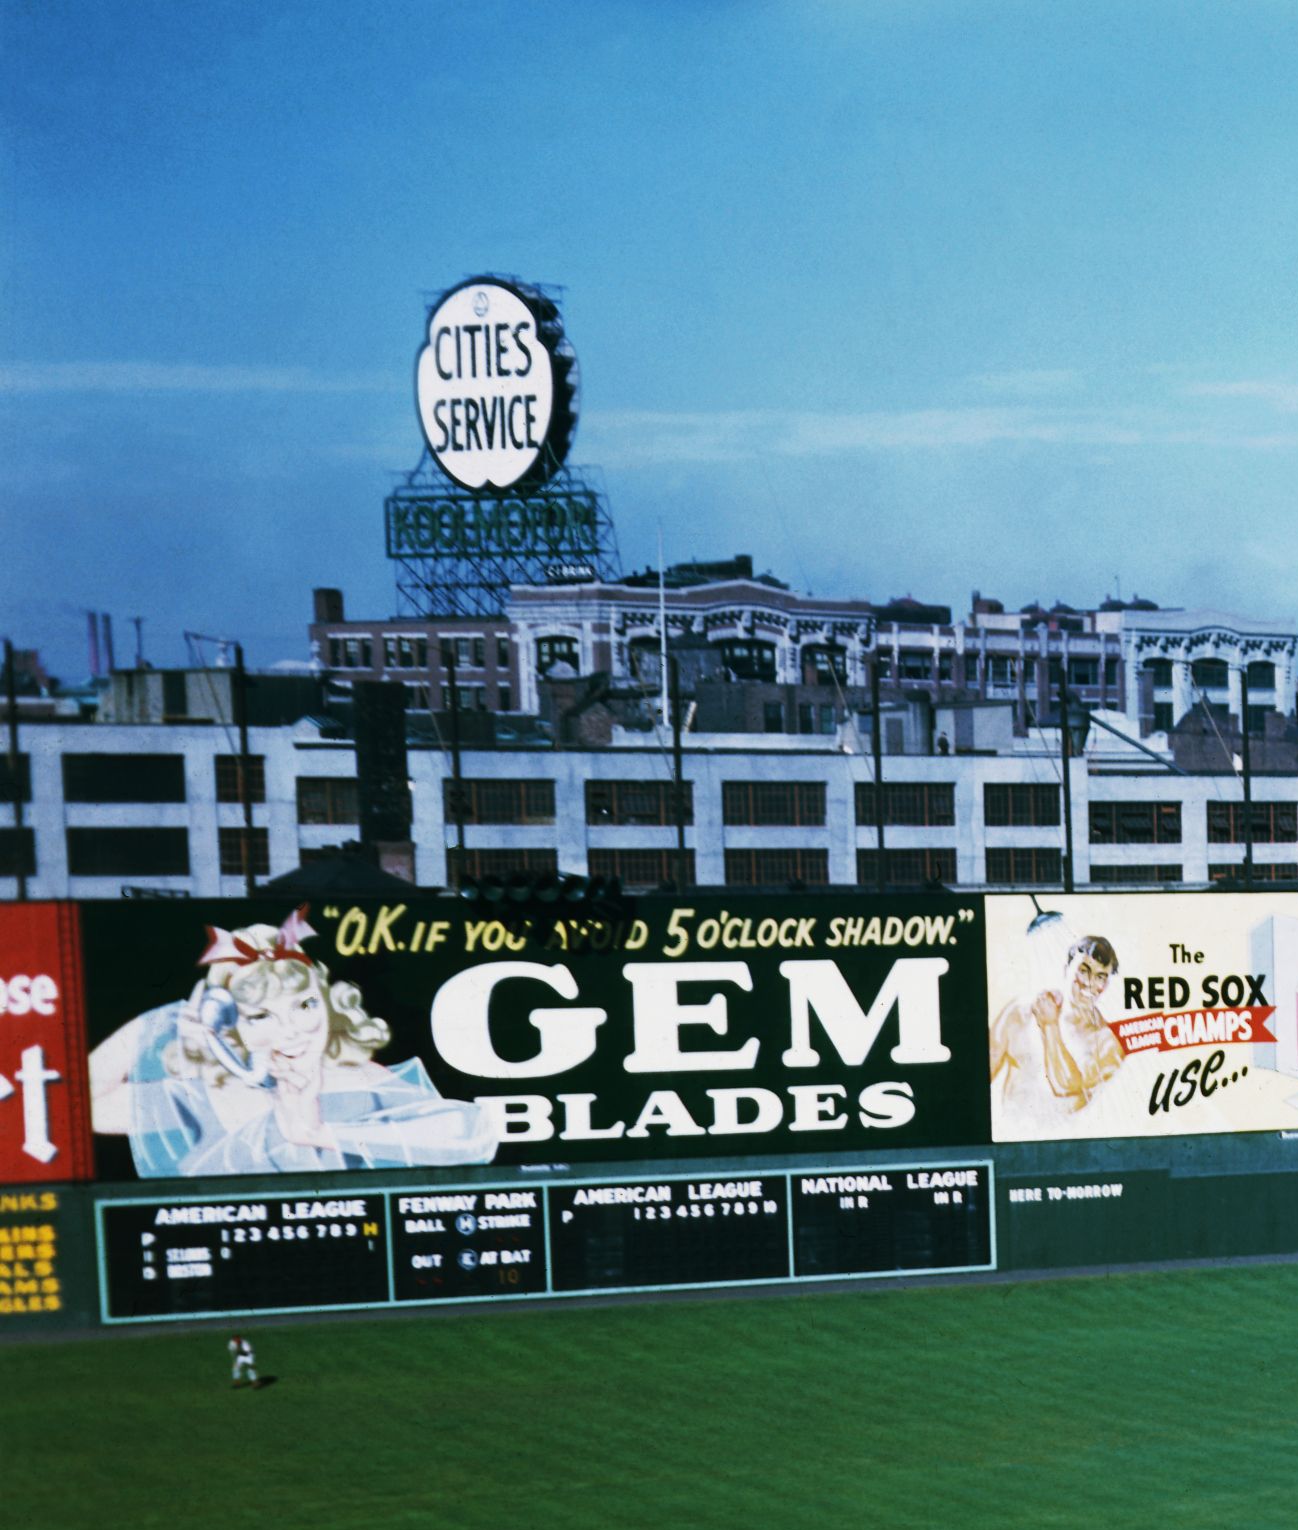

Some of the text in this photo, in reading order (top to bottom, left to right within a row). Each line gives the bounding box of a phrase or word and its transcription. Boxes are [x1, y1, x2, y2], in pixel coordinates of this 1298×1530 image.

[435, 322, 532, 380] CITIES
[433, 395, 540, 453] SERVICE
[409, 921, 451, 952] IF
[464, 920, 532, 951] YOU
[662, 908, 696, 958] 5
[697, 910, 816, 949] O'CLOCK
[825, 908, 974, 946] SHADOW."
[1169, 943, 1205, 964] The
[1123, 974, 1270, 1009] RED SOX
[430, 957, 952, 1079] GEM
[1164, 1011, 1253, 1047] CHAMPS
[474, 1081, 916, 1143] BLADES
[573, 1181, 763, 1205] AMERICAN LEAGUE
[801, 1170, 978, 1195] NATIONAL LEAGUE
[1009, 1184, 1123, 1202] HERE TO-MORROW
[399, 1192, 537, 1214] FENWAY PARK
[858, 1196, 868, 1208] R
[952, 1191, 963, 1204] R
[155, 1200, 367, 1225] AMERICAN LEAGUE
[405, 1219, 446, 1233] BALL
[478, 1214, 531, 1229] STRIKE
[562, 1210, 574, 1223] P
[633, 1207, 641, 1220] 1
[645, 1206, 656, 1219] 2
[660, 1205, 671, 1219] 3
[676, 1204, 688, 1218] 4
[690, 1204, 701, 1217] 5
[704, 1203, 715, 1217] 6
[721, 1202, 731, 1216] 7
[734, 1202, 745, 1215] 8
[748, 1201, 759, 1214] 9
[141, 1222, 378, 1247] P 1 2 3 4 5 6 7 8 9 H
[411, 1254, 443, 1269] OUT
[480, 1251, 497, 1265] AT
[500, 1249, 531, 1264] BAT
